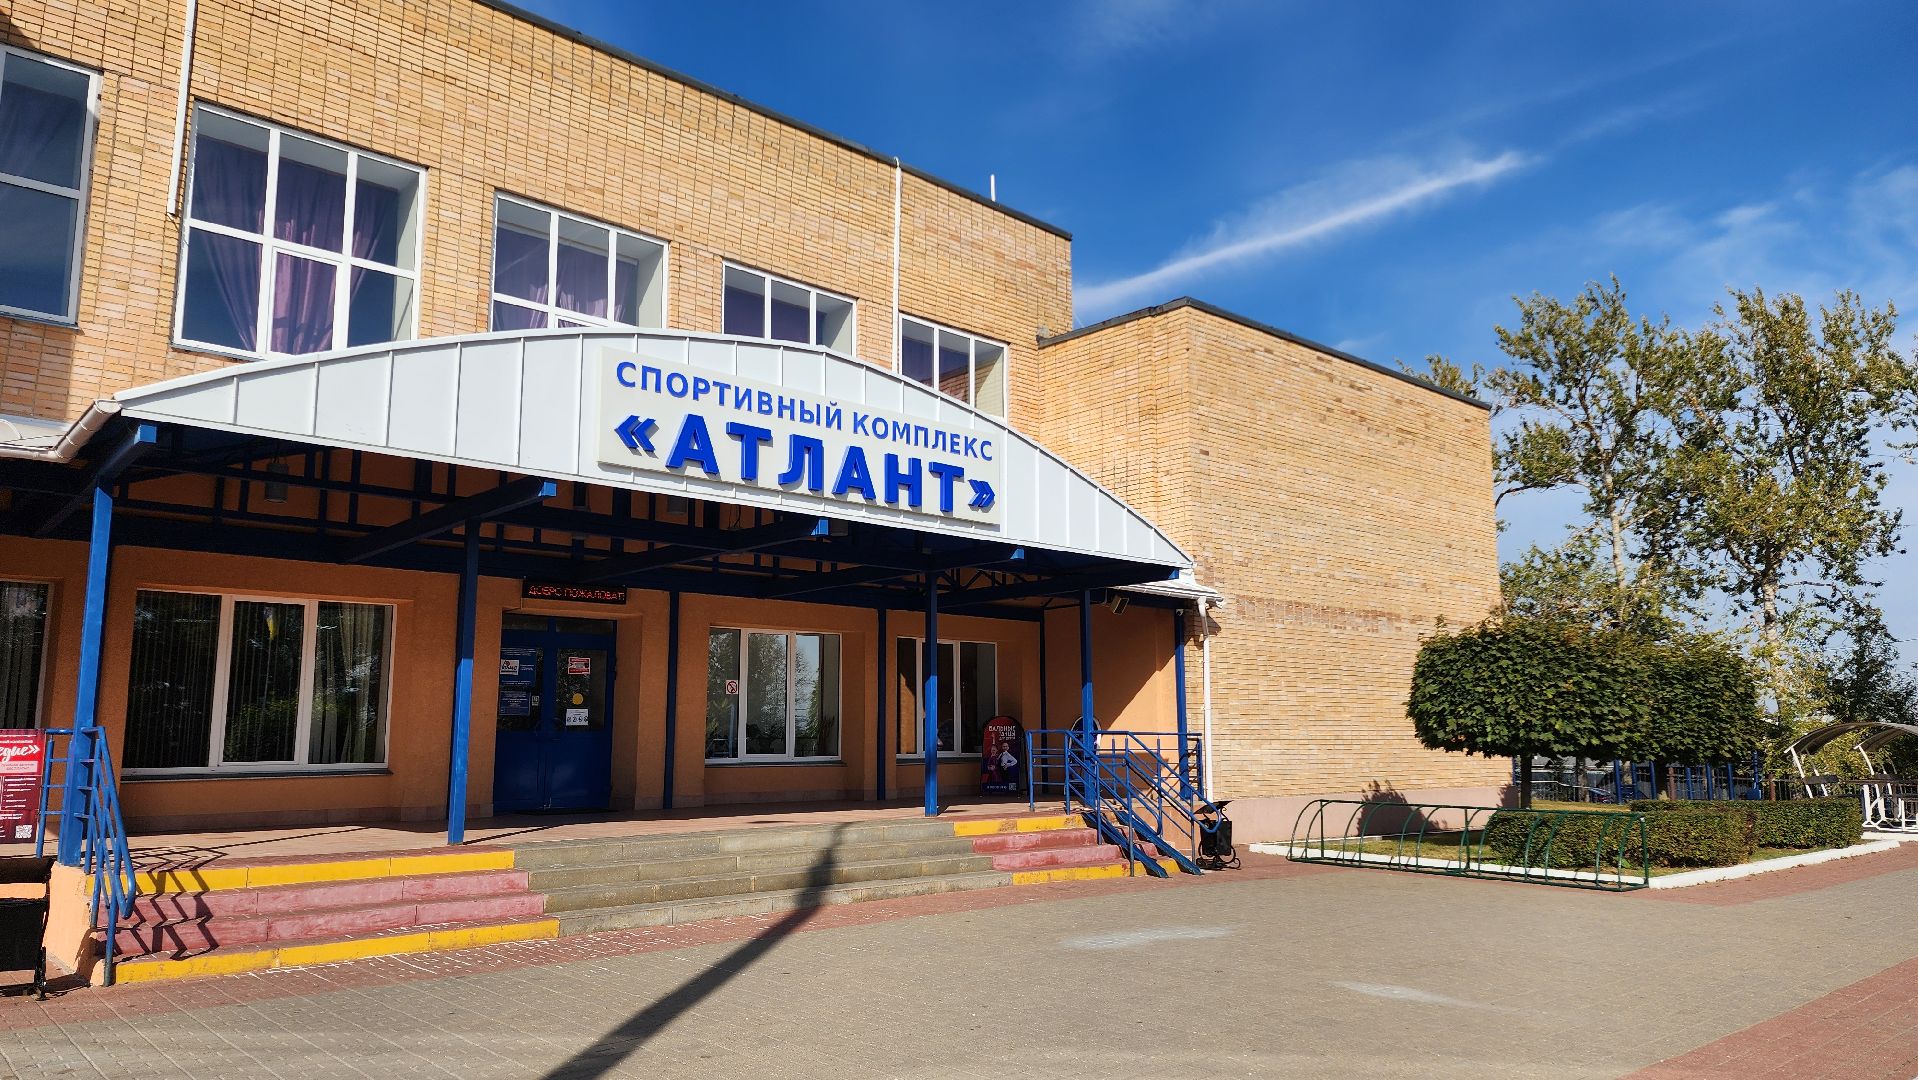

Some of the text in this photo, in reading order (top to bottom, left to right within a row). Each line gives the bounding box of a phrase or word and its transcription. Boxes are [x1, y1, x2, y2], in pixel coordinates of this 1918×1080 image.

[616, 361, 993, 461] СПОРТИВНЫЙ КОМПЛЕКС
[614, 413, 996, 513] «АТЛАНТ»
[528, 584, 561, 597] ДОБРО
